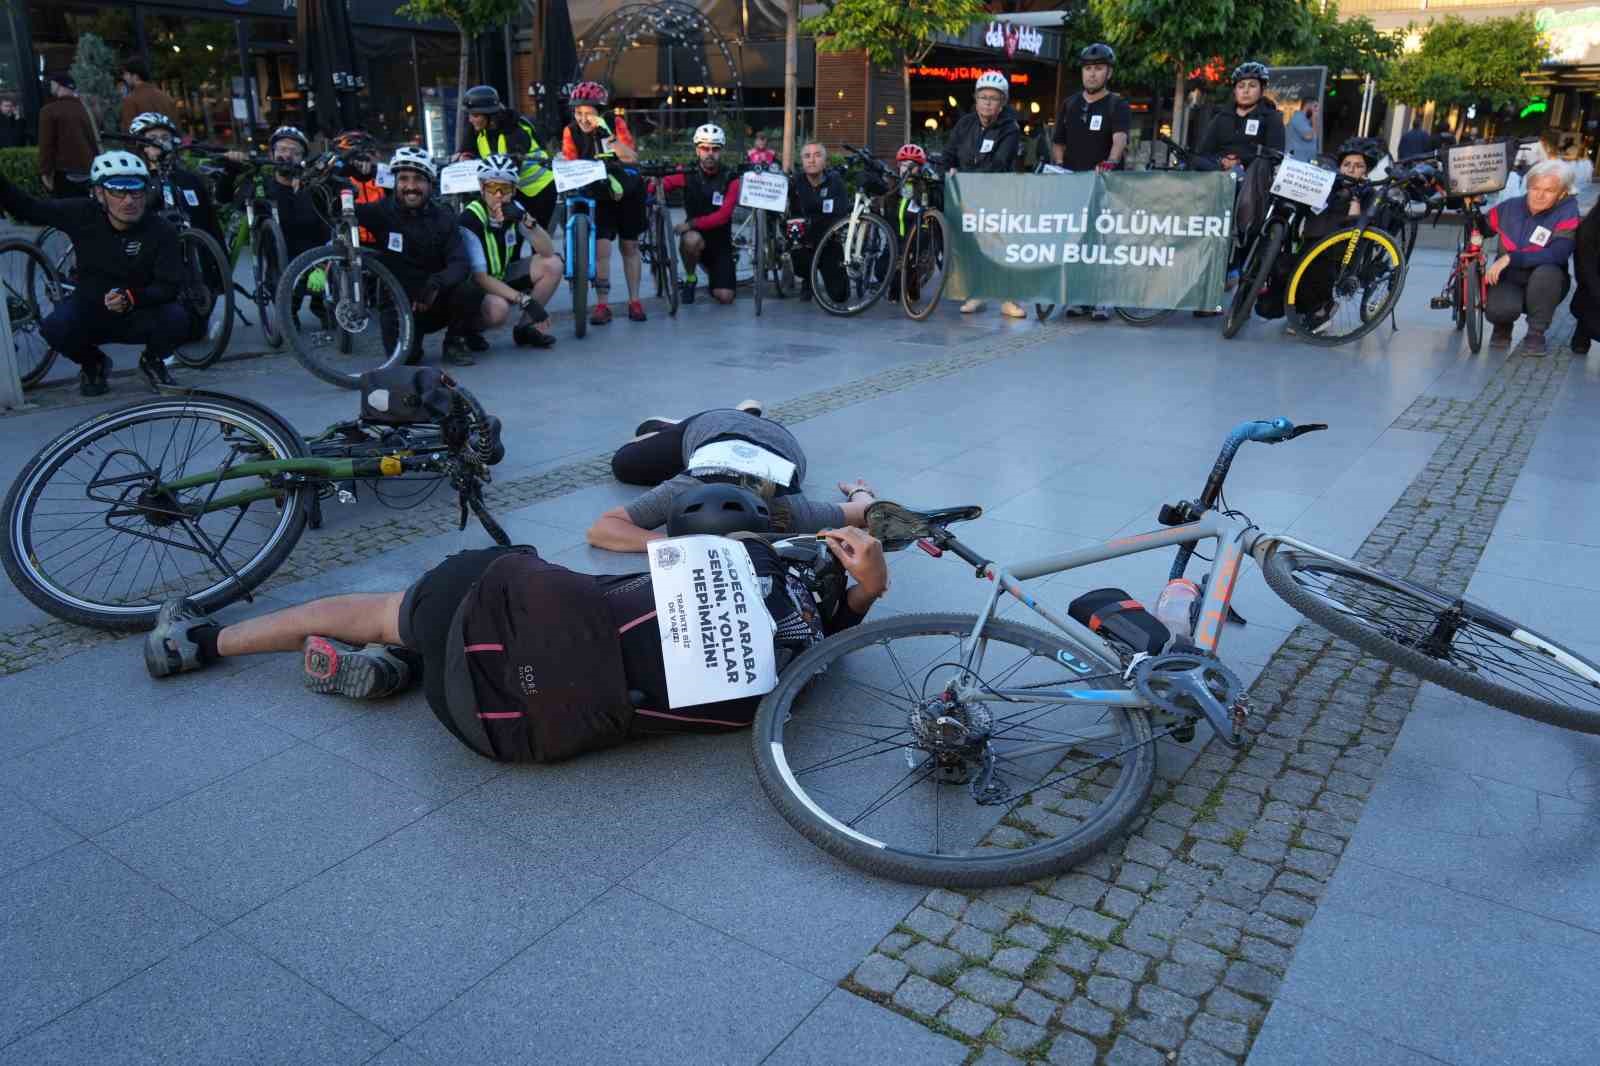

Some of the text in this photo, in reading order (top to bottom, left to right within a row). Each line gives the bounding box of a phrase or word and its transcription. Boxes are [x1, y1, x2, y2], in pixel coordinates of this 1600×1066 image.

[962, 208, 1231, 238] BİSİKLETLİ ÖLÜMLERİ
[1005, 243, 1176, 267] SON BULSUN!
[668, 602, 675, 612] DE
[692, 568, 720, 669] HEPİMİZİN!
[721, 547, 757, 684] SADECE ARABA
[718, 611, 739, 683] YOLLAR
[524, 665, 538, 695] GORE
